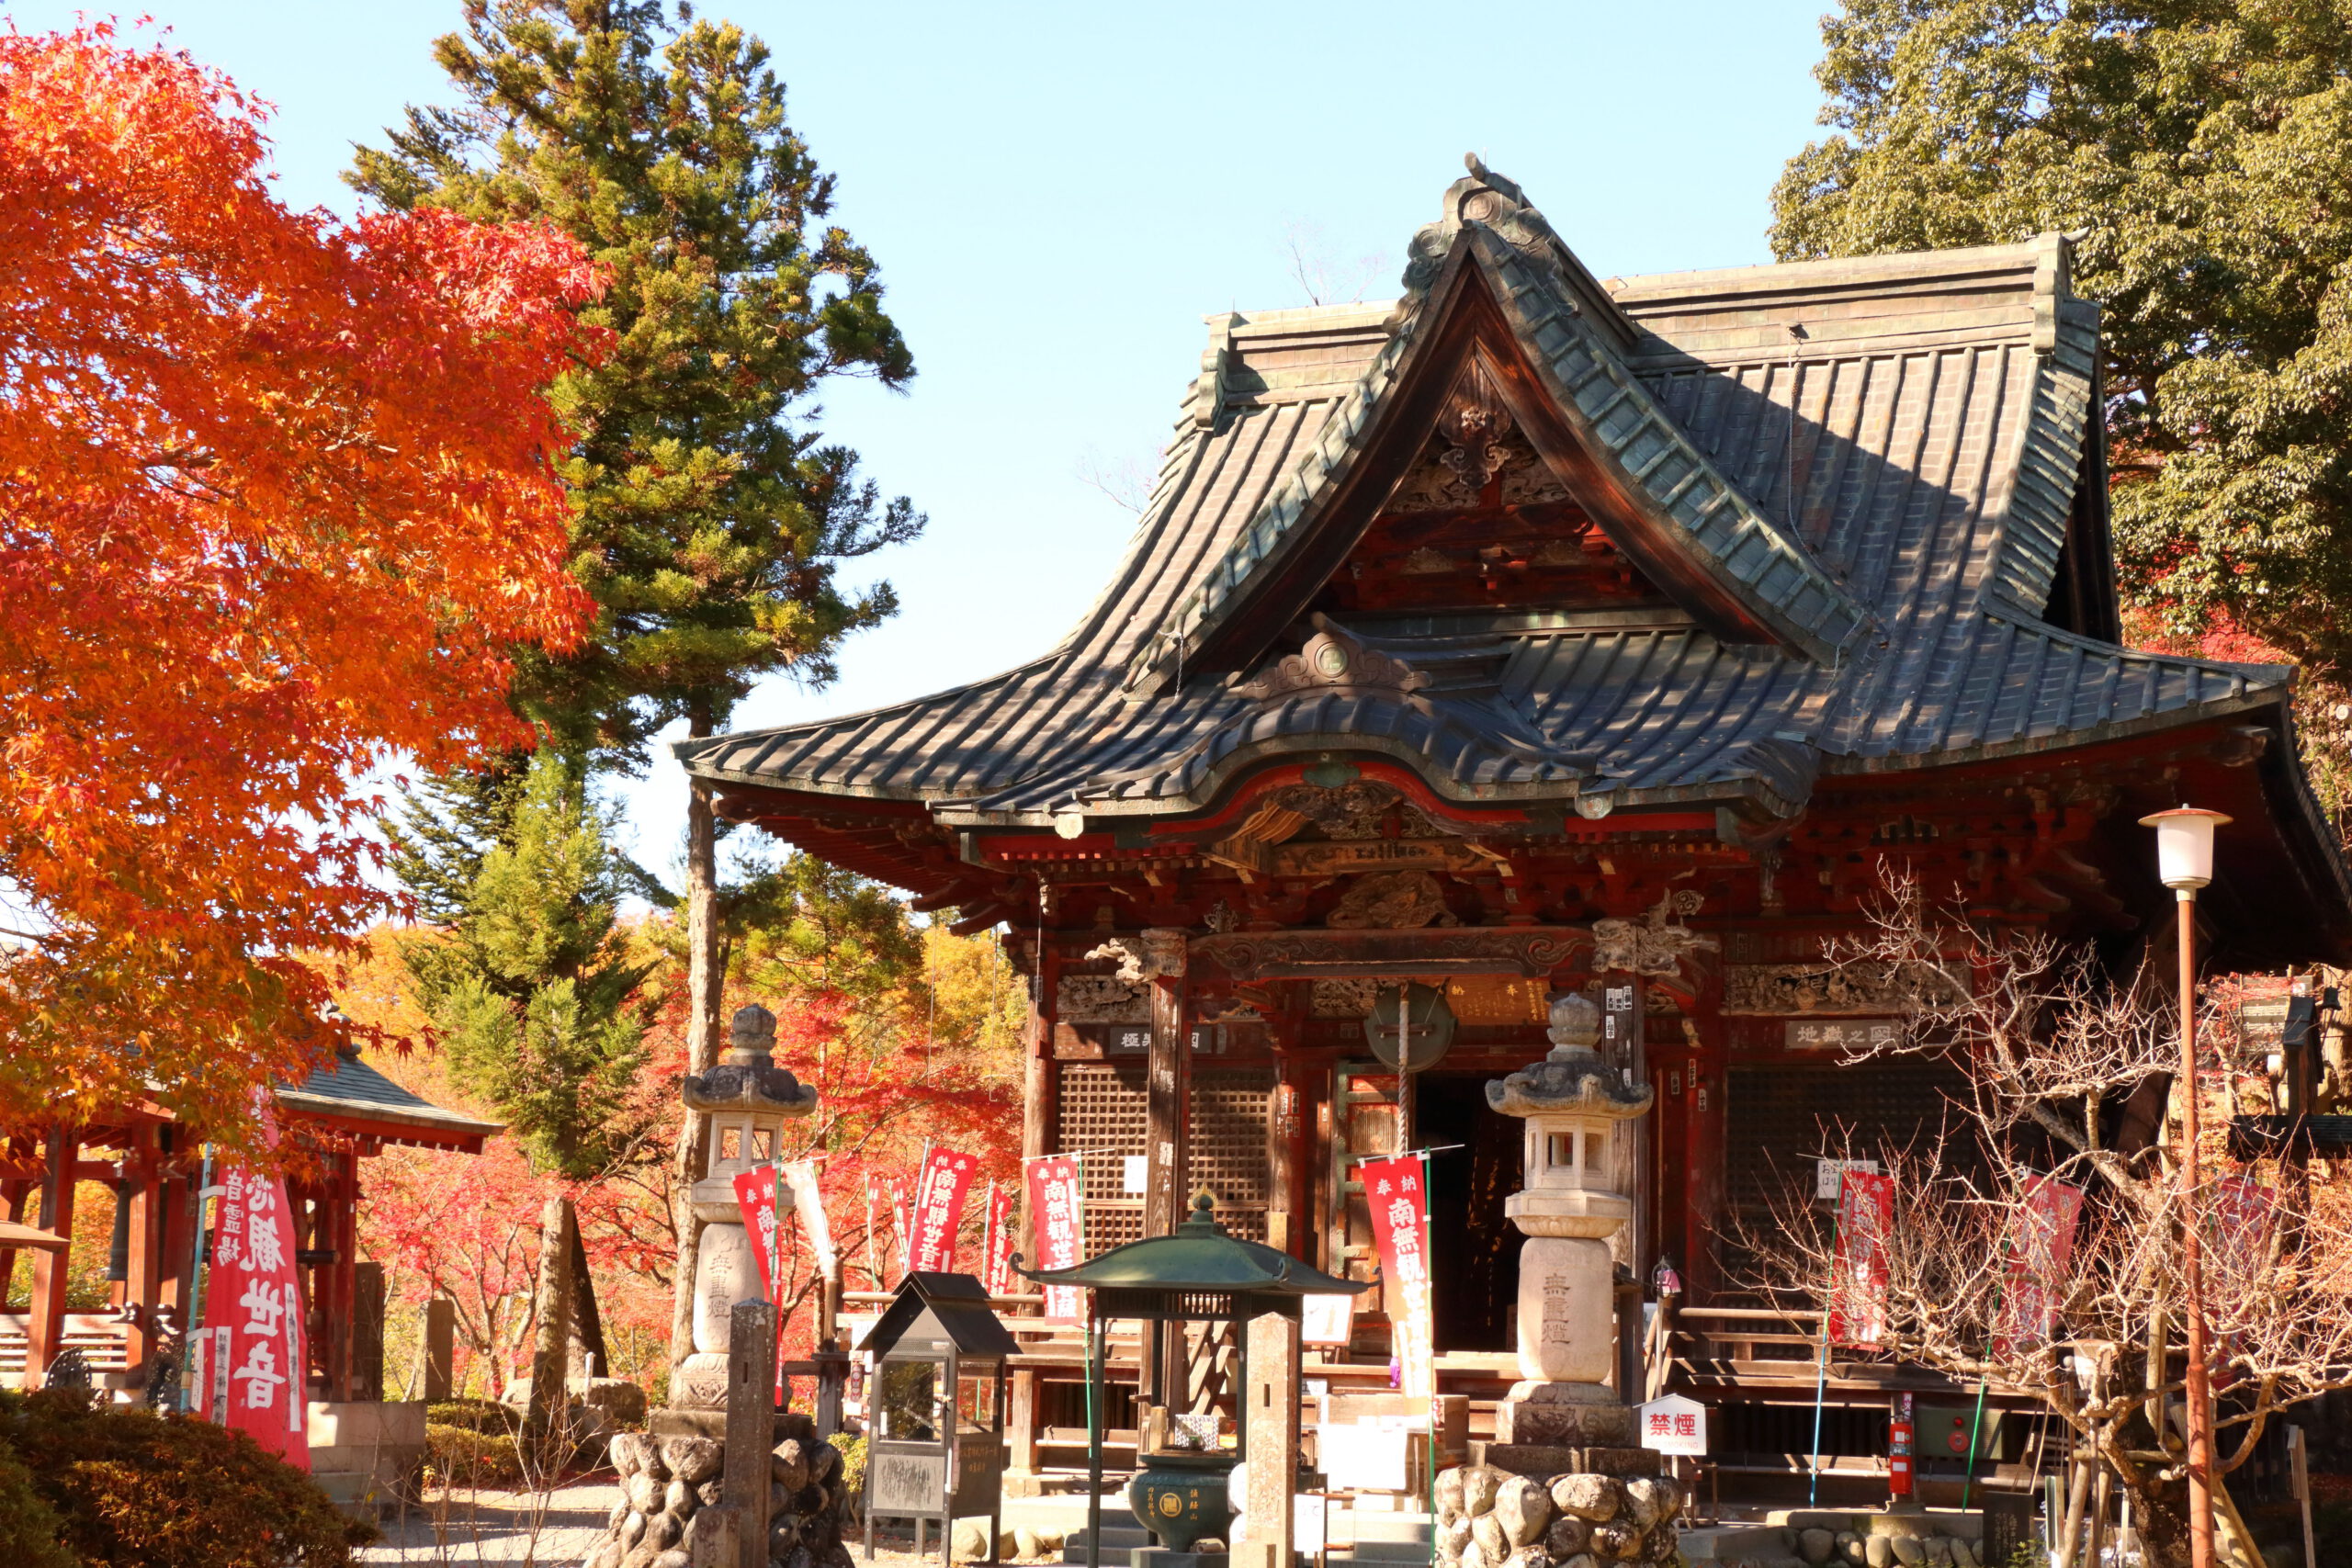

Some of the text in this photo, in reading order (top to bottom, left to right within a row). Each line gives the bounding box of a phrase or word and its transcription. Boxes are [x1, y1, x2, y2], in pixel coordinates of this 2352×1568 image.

[1036, 1167, 1069, 1179] 奉納
[746, 1183, 774, 1204] 奉納
[1376, 1175, 1417, 1196] 奉納
[1650, 1413, 1696, 1436] 禁煙
